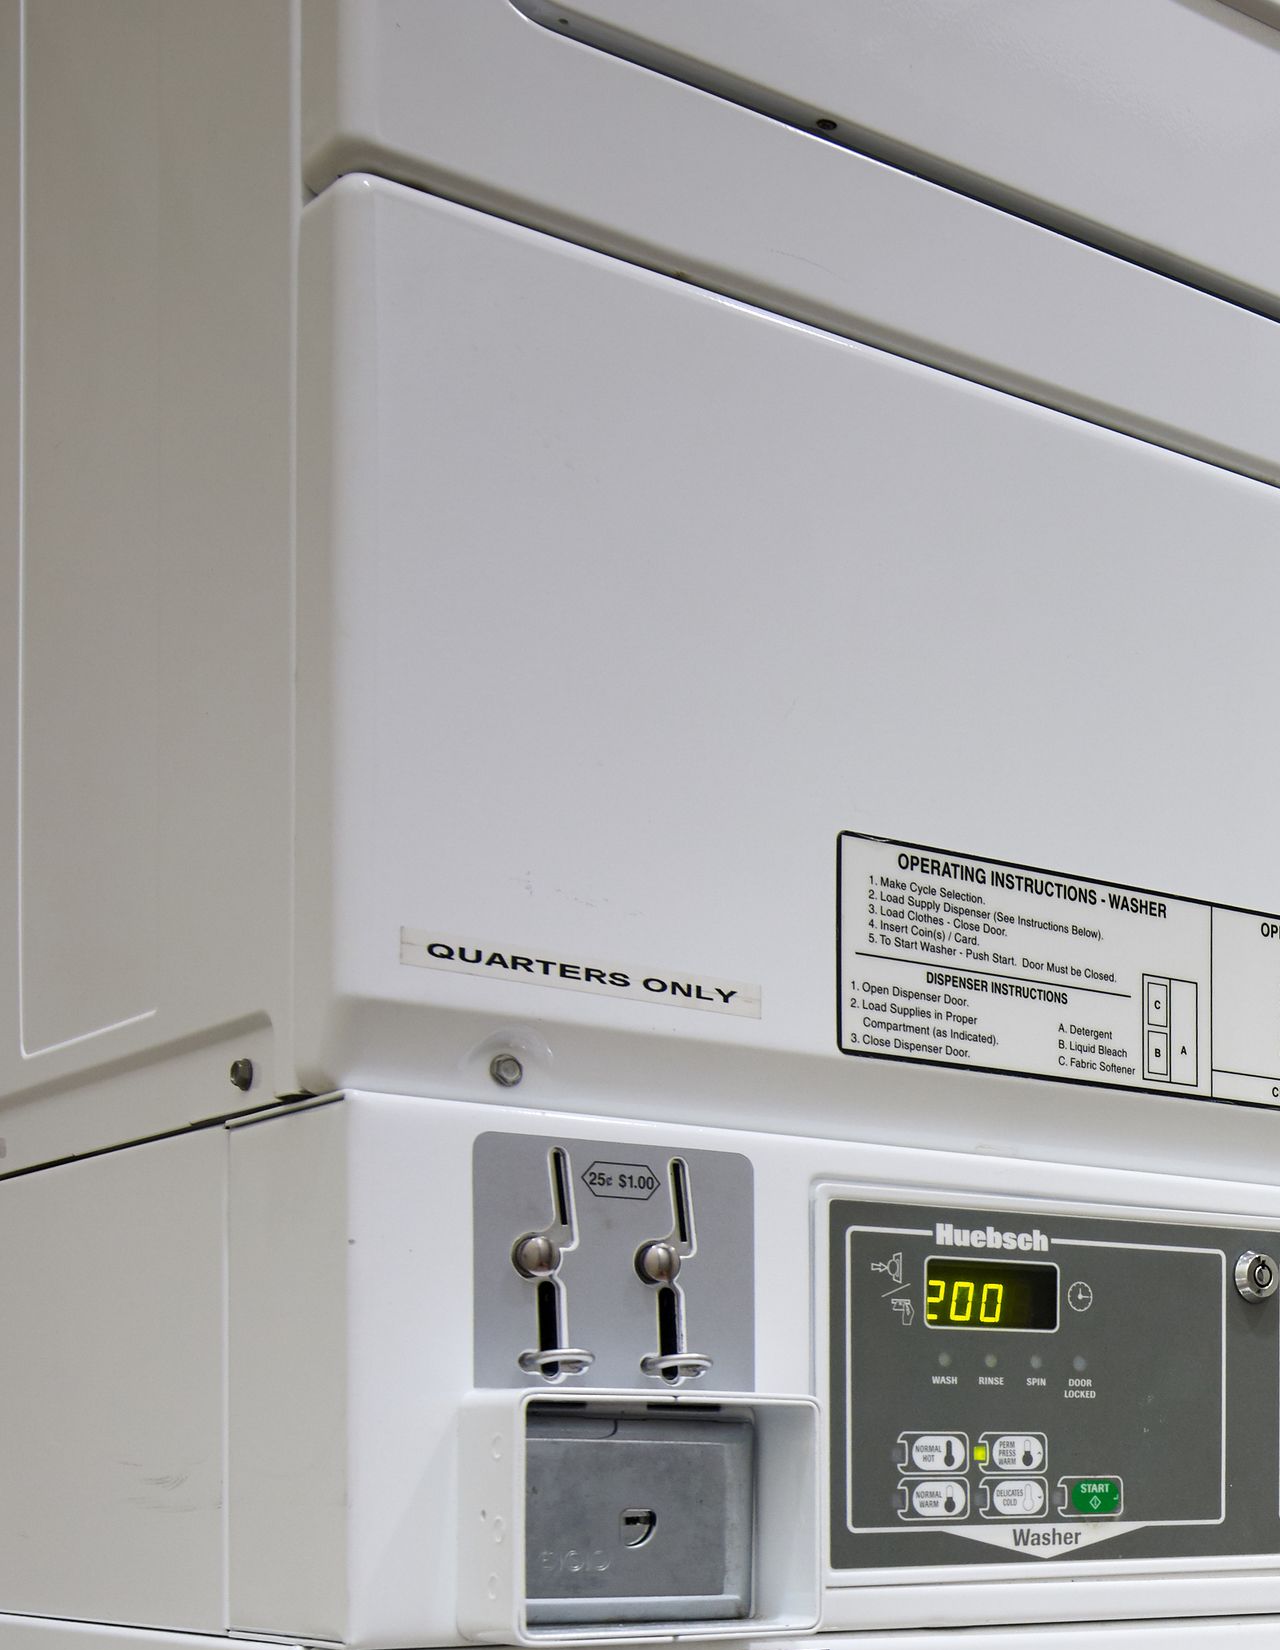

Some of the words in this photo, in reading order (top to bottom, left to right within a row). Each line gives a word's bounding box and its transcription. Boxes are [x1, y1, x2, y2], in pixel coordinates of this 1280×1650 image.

[869, 875, 878, 886] 1.
[880, 876, 907, 891] Make
[909, 881, 937, 897] Cycle
[939, 887, 986, 905] Selection.
[897, 853, 987, 885] OPERATING
[990, 870, 1098, 906] INSTRUCTIONS
[1108, 892, 1167, 919] WASHER
[868, 888, 878, 900] 2.
[880, 890, 905, 905] Load
[907, 895, 941, 914] Supply
[943, 901, 991, 920] Dispenser
[993, 911, 1015, 925] (See
[1017, 915, 1069, 934] Instructions
[1071, 924, 1104, 942] Below).
[868, 903, 878, 915] 3.
[880, 905, 905, 920] Load
[907, 909, 944, 926] Clothes
[952, 917, 981, 932] Close
[983, 922, 1008, 937] Door.
[868, 918, 878, 929] 4.
[880, 919, 909, 935] Insert
[910, 924, 946, 943] Coin(s)
[954, 932, 980, 946] Card.
[426, 943, 631, 988] QUARTERS
[642, 977, 738, 1004] ONLY
[926, 971, 988, 993] DISPENSER
[991, 981, 1068, 1005] INSTRUCTIONS
[1154, 999, 1161, 1010] C
[850, 997, 860, 1009] 2.
[862, 999, 887, 1013] Load
[889, 1002, 932, 1019] Supplies
[934, 1009, 943, 1021] in
[945, 1010, 978, 1026] Proper
[862, 1016, 930, 1036] Compartment
[932, 1026, 948, 1039] (as
[950, 1028, 999, 1047] Indicated).
[1058, 1023, 1068, 1034] A.
[1069, 1024, 1113, 1041] Detergent
[1058, 1038, 1068, 1050] B.
[1069, 1040, 1096, 1055] Liquid
[1098, 1044, 1128, 1058] Bleach
[1154, 1047, 1161, 1058] B
[1058, 1055, 1068, 1067] C.
[1070, 1057, 1097, 1071] Fabric
[1099, 1061, 1136, 1076] Softener
[617, 1173, 655, 1192] $1.00
[935, 1222, 1049, 1252] Huebsch
[931, 1375, 958, 1385] WASH
[978, 1376, 1004, 1386] RINSE
[1026, 1377, 1047, 1387] SPIN
[1068, 1378, 1092, 1388] DOOR
[1064, 1389, 1096, 1399] LOCKED
[915, 1444, 942, 1454] NORMAL
[999, 1440, 1016, 1449] PERM
[922, 1454, 935, 1463] HOT
[998, 1449, 1017, 1458] PRESS
[998, 1457, 1017, 1465] WARM
[995, 1488, 1024, 1498] DELICATES
[1080, 1483, 1109, 1494] START
[915, 1490, 943, 1499] NORMAL
[919, 1500, 939, 1508] WARM
[1002, 1498, 1018, 1507] COLD
[1012, 1527, 1082, 1547] Washer
